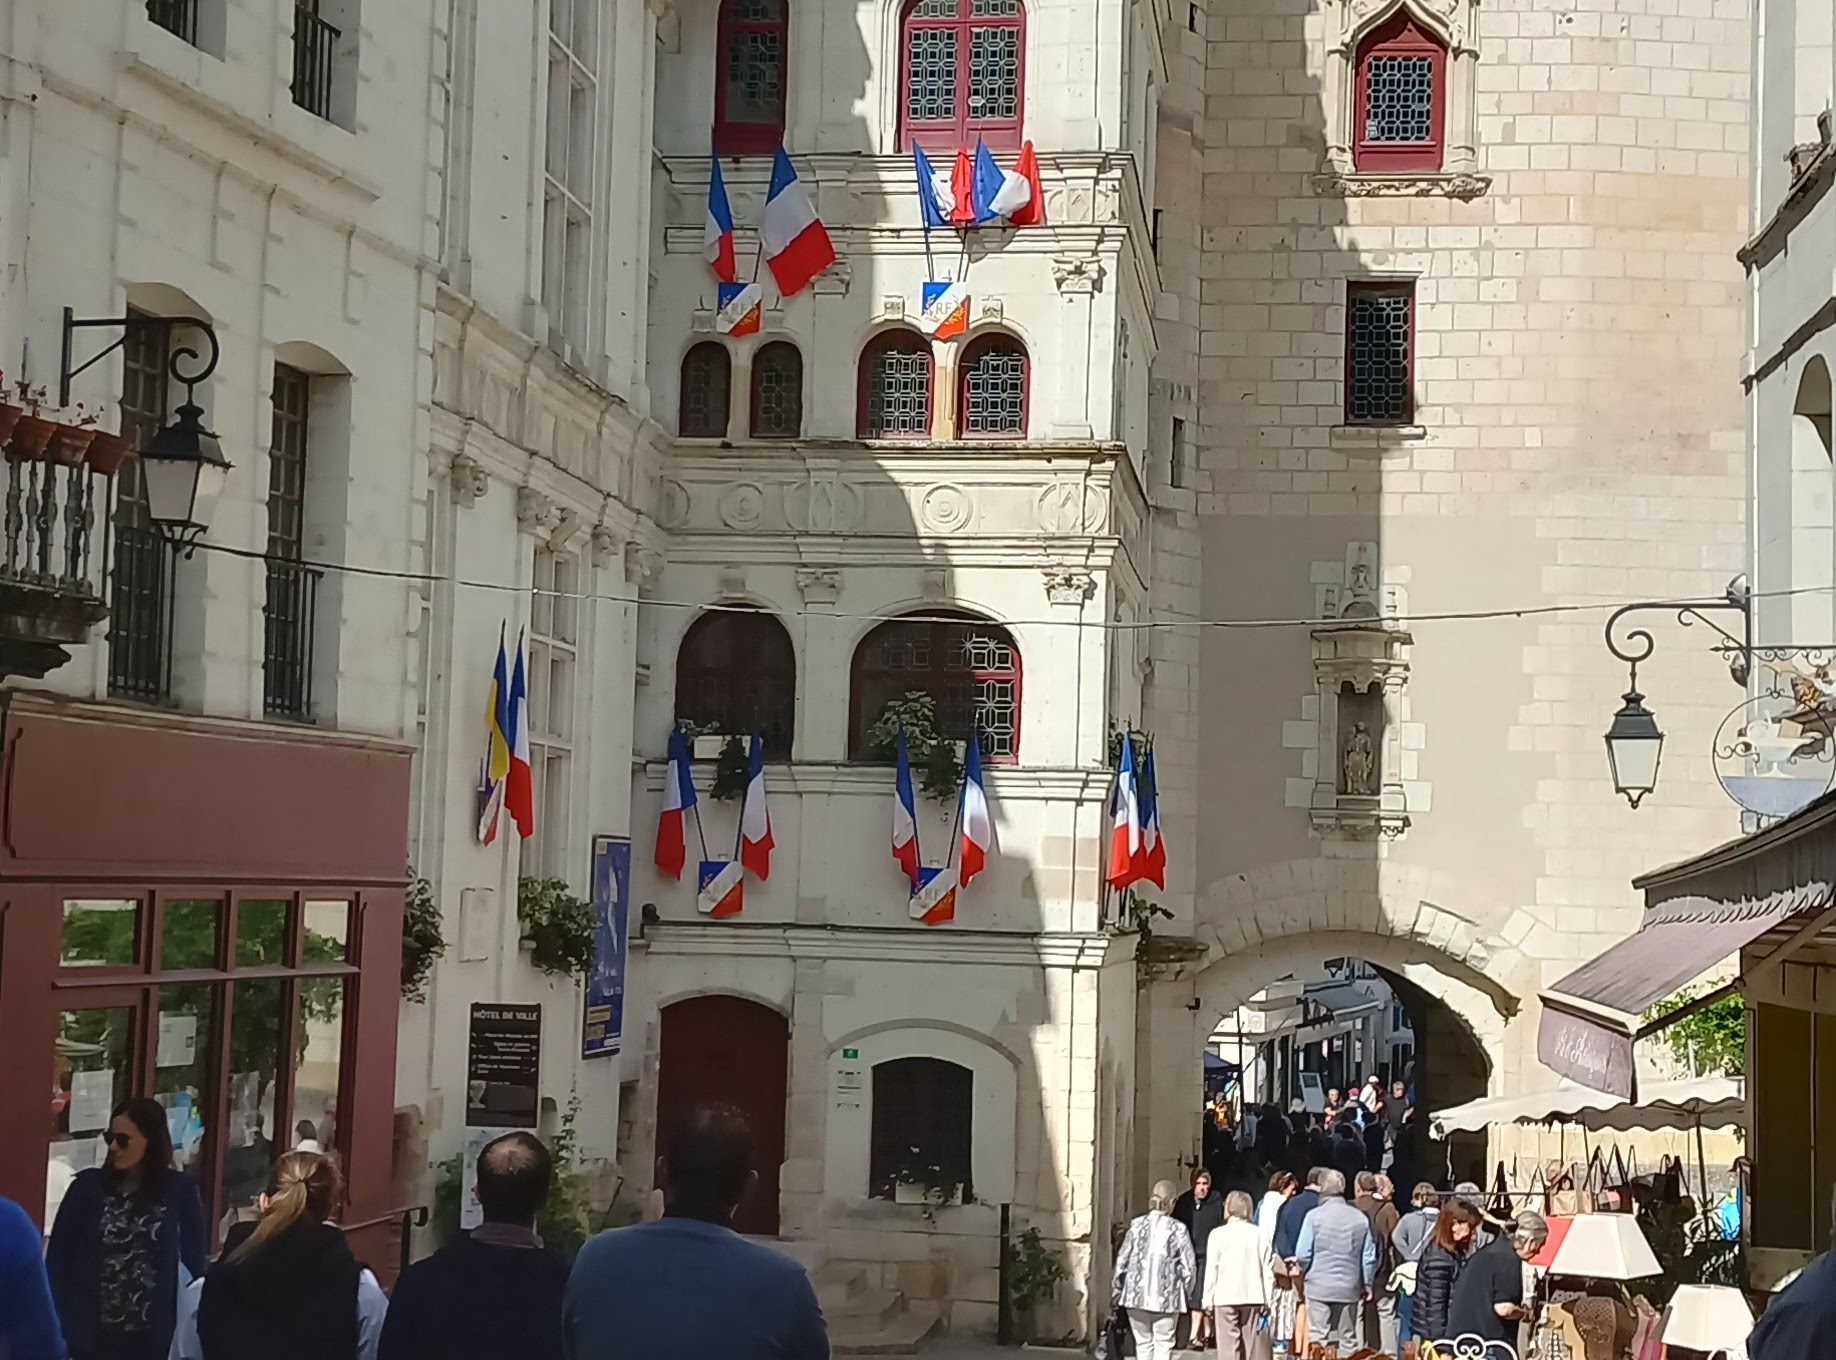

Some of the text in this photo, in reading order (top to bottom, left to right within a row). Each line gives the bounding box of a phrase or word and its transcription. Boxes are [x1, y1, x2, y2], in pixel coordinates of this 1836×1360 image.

[473, 1010, 538, 1021] HÔTEL DE VILLE
